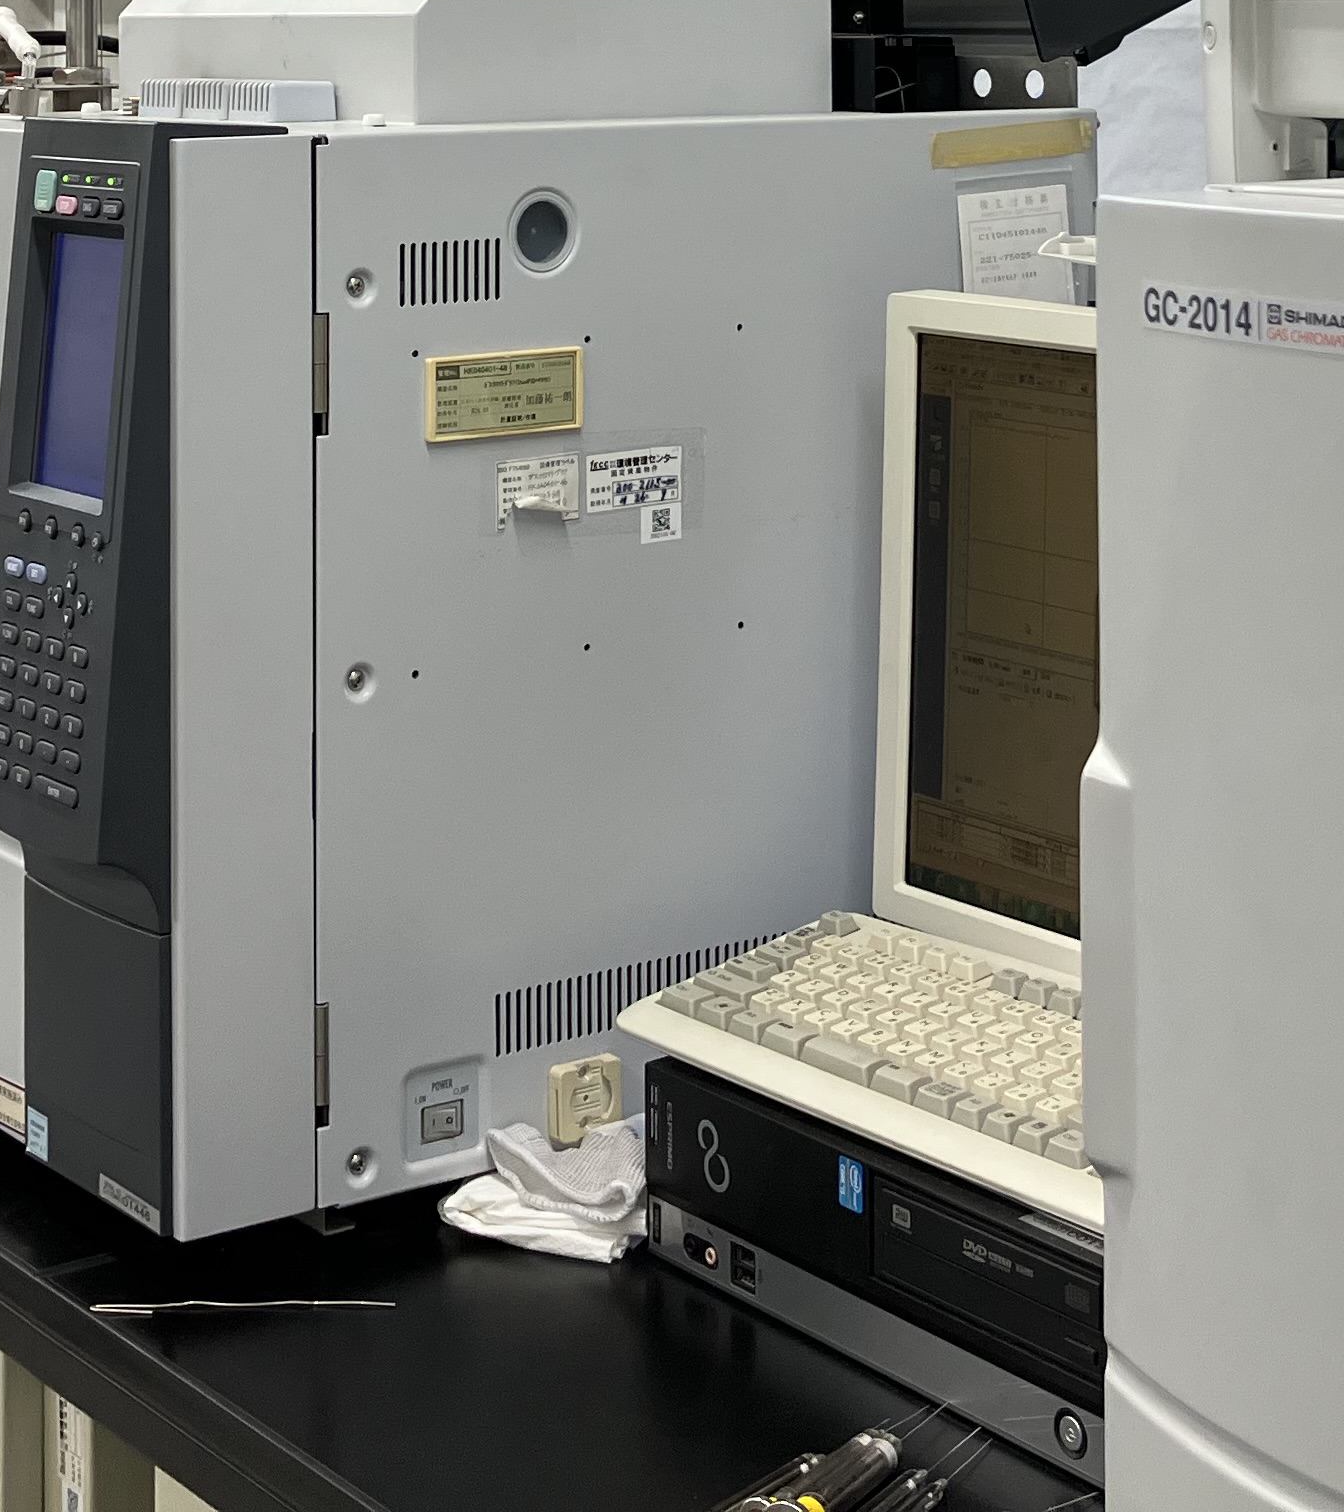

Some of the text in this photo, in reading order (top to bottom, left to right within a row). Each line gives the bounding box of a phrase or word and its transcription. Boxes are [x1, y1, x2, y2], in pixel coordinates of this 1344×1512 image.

[1143, 287, 1252, 336] GC-2014
[1266, 326, 1288, 342] GAS
[962, 1238, 988, 1257] DVD
